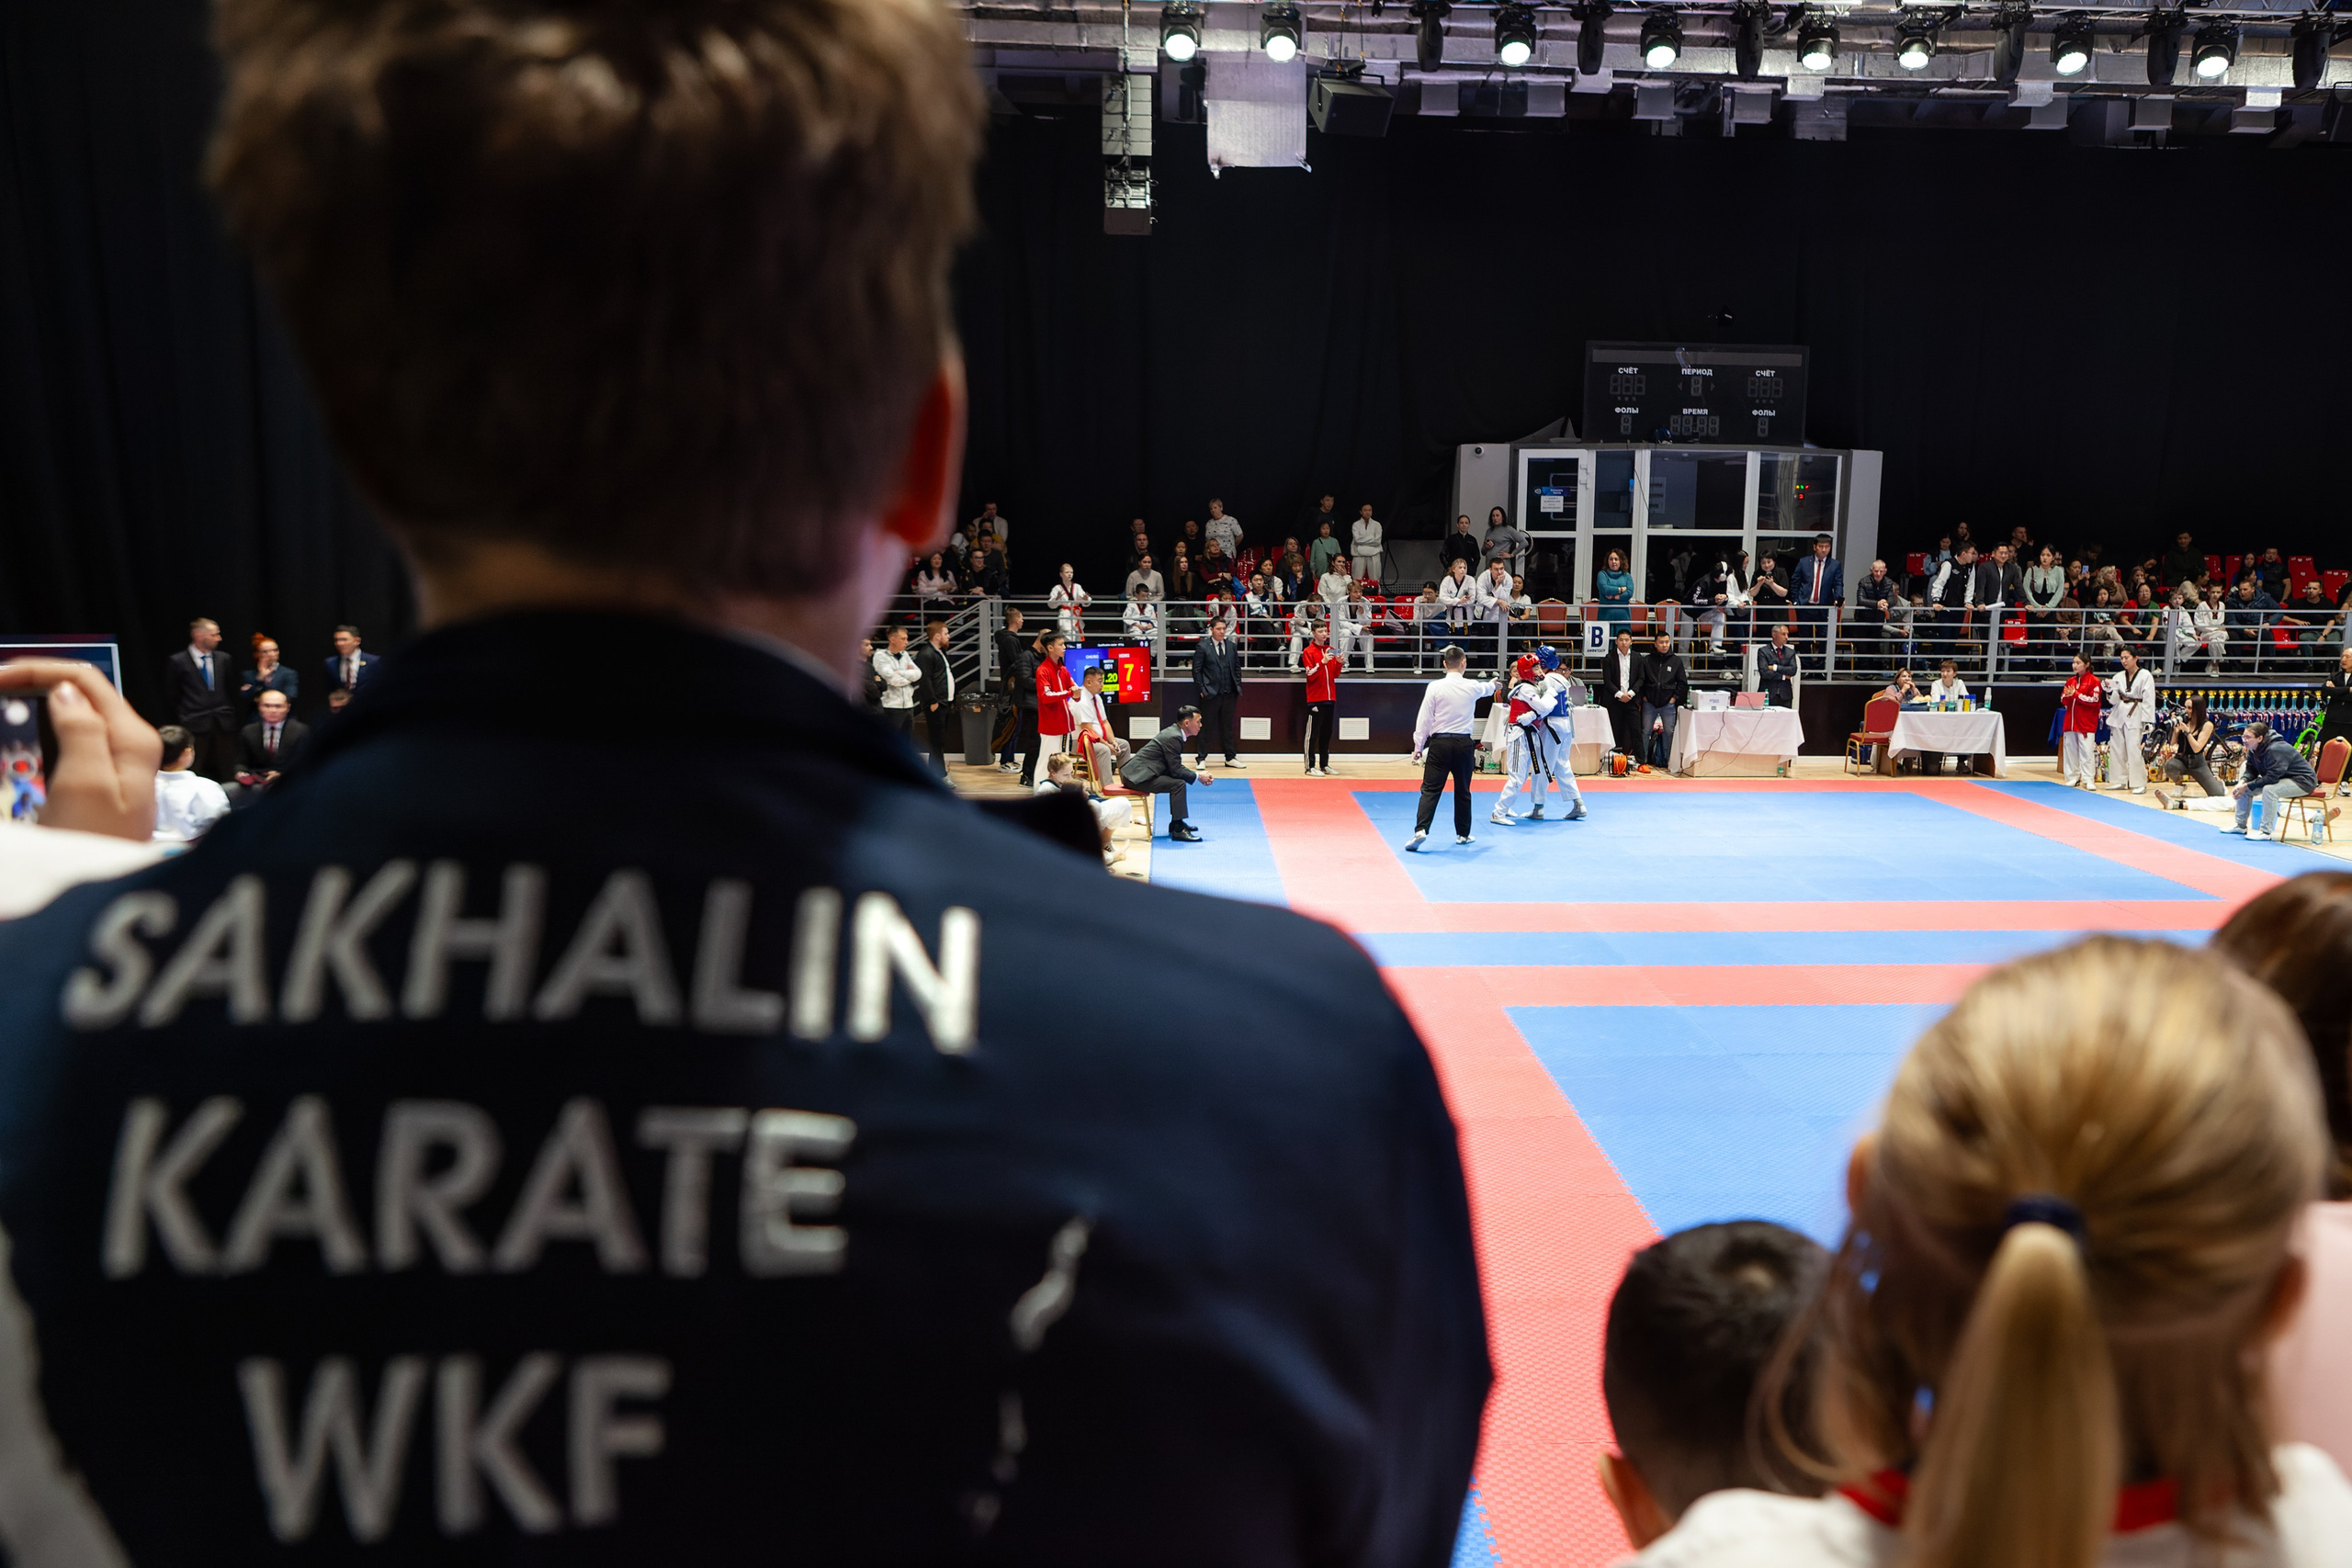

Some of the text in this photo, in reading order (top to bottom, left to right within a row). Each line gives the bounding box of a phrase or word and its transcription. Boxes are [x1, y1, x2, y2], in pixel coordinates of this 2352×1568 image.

[1681, 368, 1713, 377] ПЕРИОД
[1751, 409, 1776, 417] ФОЛЫ
[1124, 664, 1134, 682] 7
[61, 858, 982, 1056] SAKHALIN
[99, 1097, 858, 1280] KARATE
[237, 1350, 673, 1543] WKF
